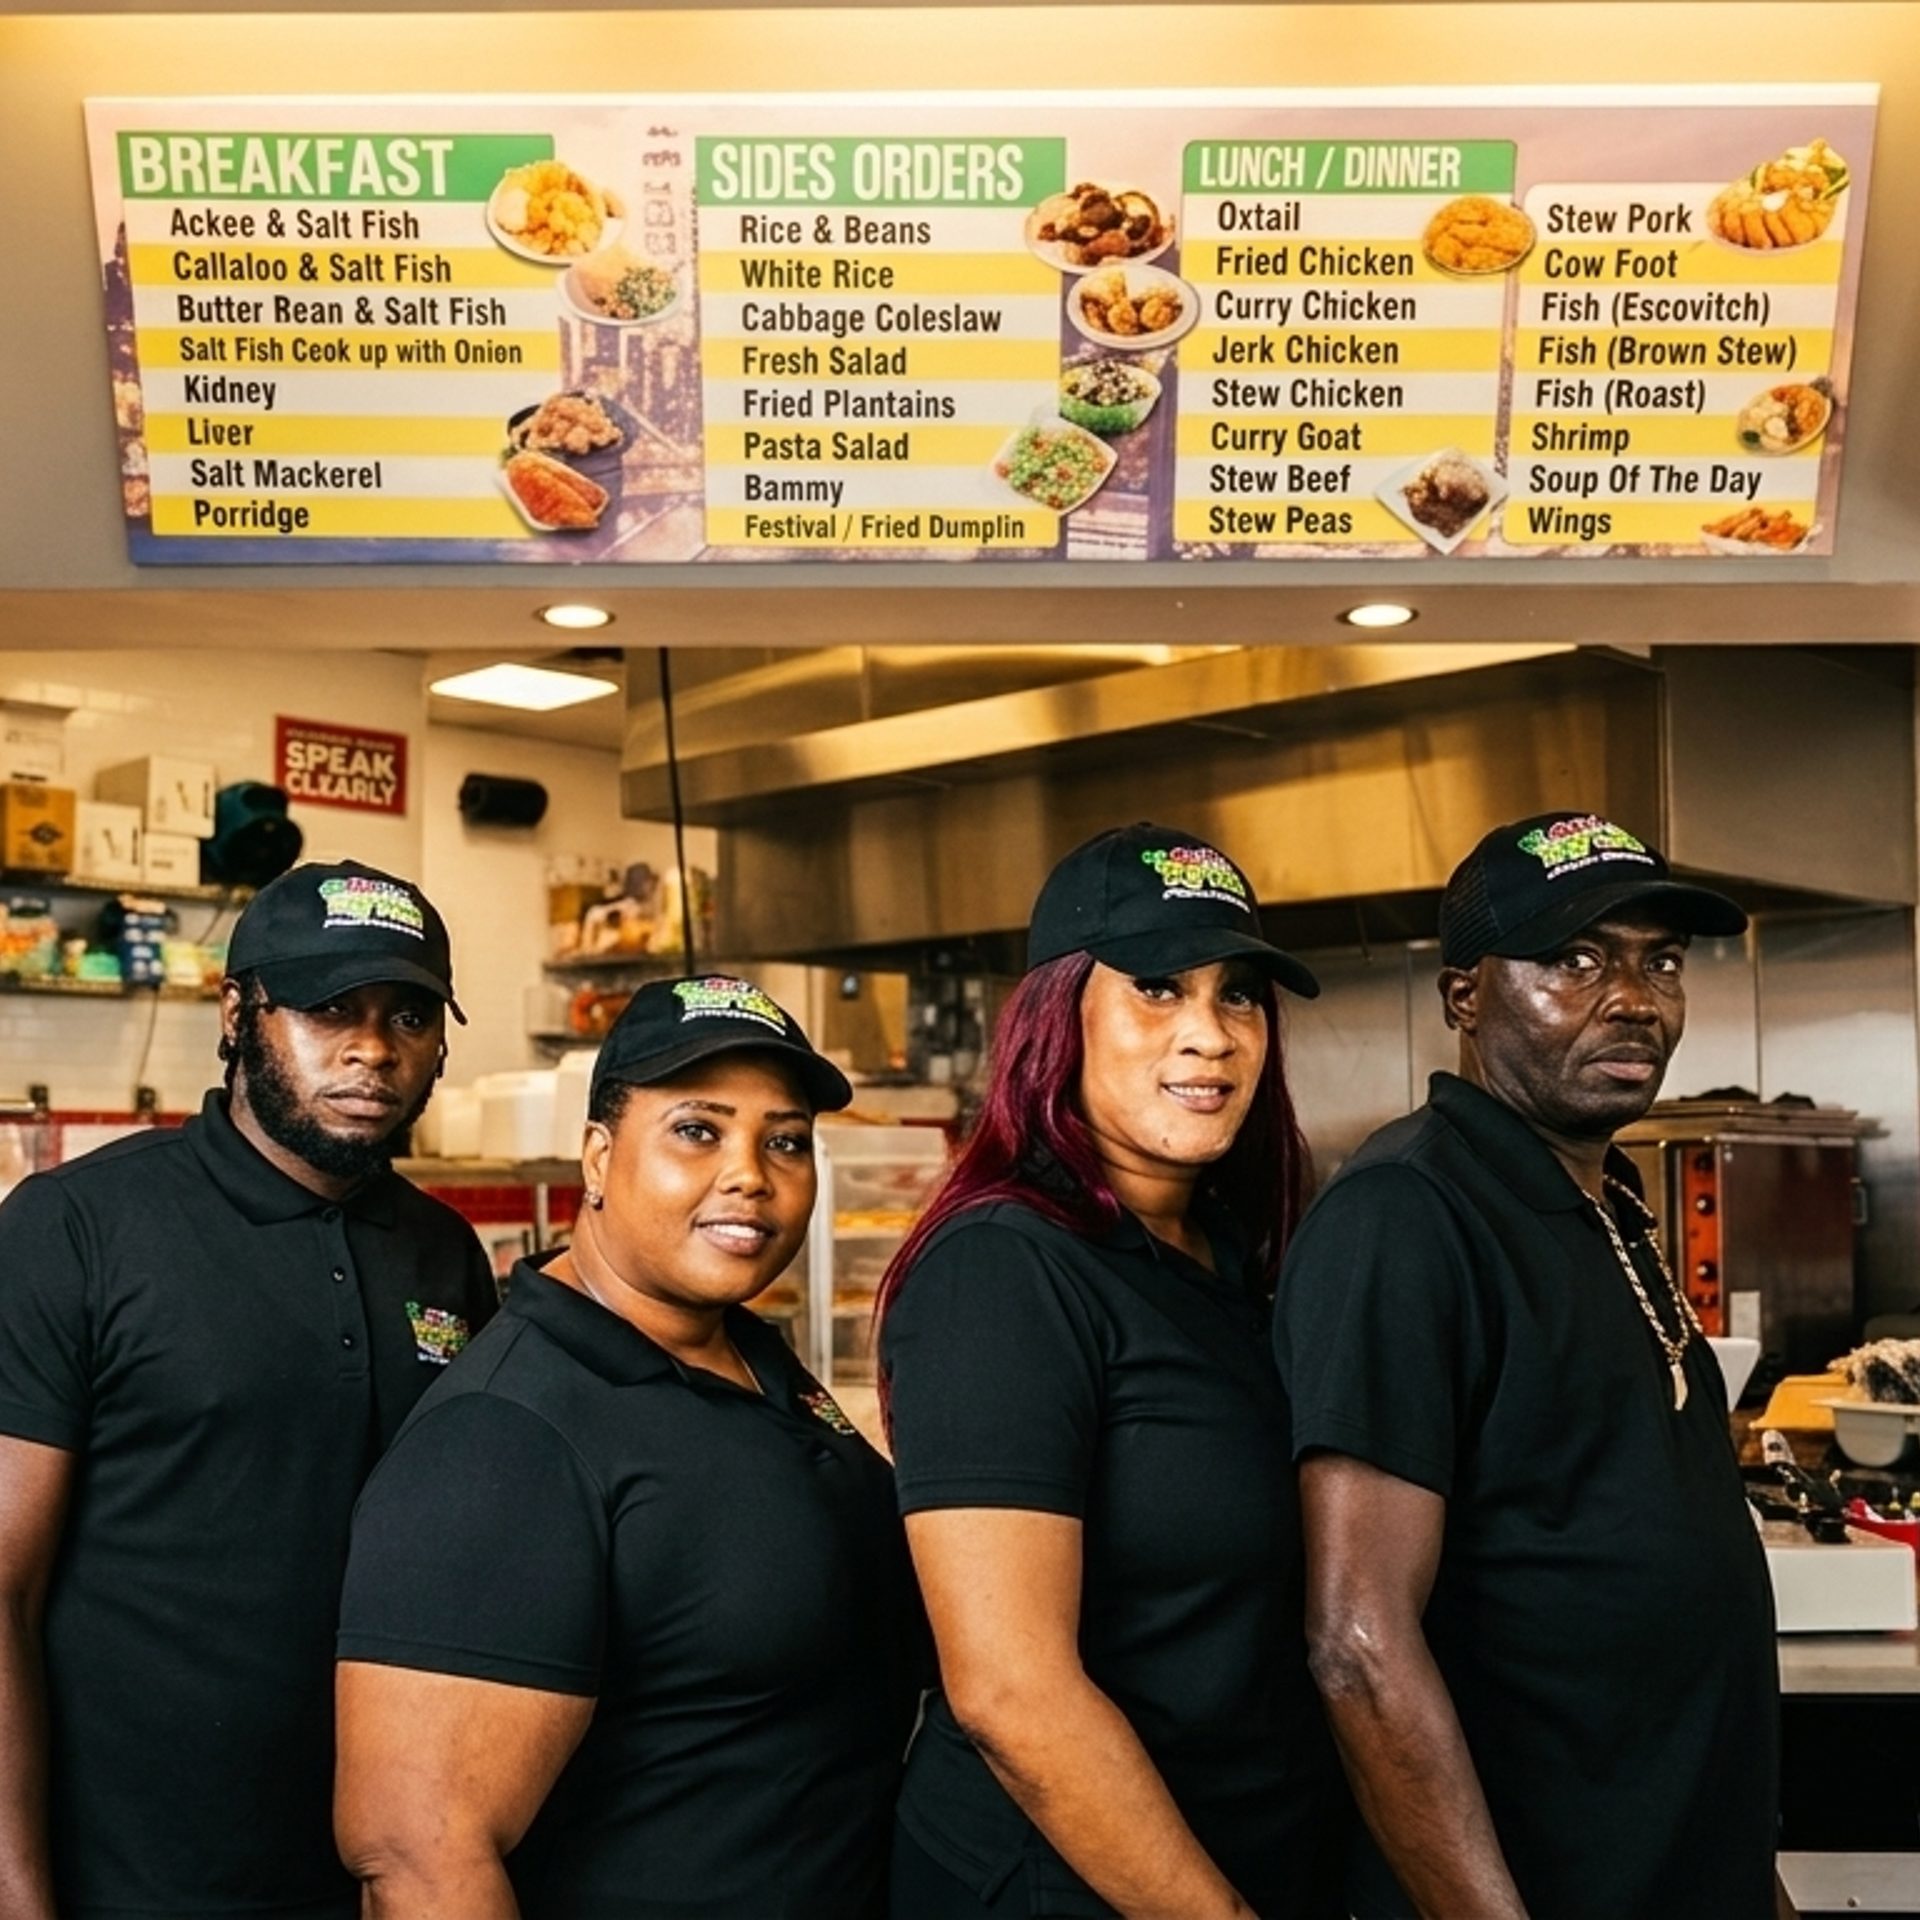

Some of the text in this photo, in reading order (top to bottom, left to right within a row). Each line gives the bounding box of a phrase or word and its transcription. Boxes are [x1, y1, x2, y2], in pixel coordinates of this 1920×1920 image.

[131, 138, 454, 196] BREAKFAST
[712, 143, 835, 200] SIDES
[854, 143, 1022, 200] ORDERS
[1201, 146, 1461, 189] LUNCH / DINNER
[171, 208, 419, 239] Ackee & Salt Fish
[741, 215, 931, 244] Rice & Beans
[1218, 201, 1300, 231] Oxtail
[1547, 203, 1691, 233] Stew Pork
[174, 251, 451, 283] Callaloo & Salt Fish
[740, 259, 893, 288] White Rice
[1217, 246, 1413, 275] Fried Chicken
[1545, 248, 1678, 278] Cow Foot
[177, 294, 263, 323] Butter
[355, 296, 374, 325] &
[385, 297, 439, 325] Salt
[450, 297, 505, 325] Fish
[742, 303, 1001, 339] Cabbage Coleslaw
[1216, 290, 1416, 327] Curry Chicken
[1542, 292, 1770, 327] Fish (Escovitch)
[180, 336, 227, 362] Salt
[235, 337, 283, 362] Fish
[360, 344, 387, 369] up
[396, 339, 445, 363] with
[743, 346, 906, 375] Fresh Salad
[1213, 335, 1398, 364] Jerk Chicken
[1539, 336, 1796, 371] Fish (Brown Stew)
[185, 375, 275, 410] Kidney
[744, 389, 955, 418] Fried Plantains
[1212, 378, 1403, 408] Stew Chicken
[1536, 378, 1705, 414] Fish (Roast)
[187, 418, 253, 446] Liver
[745, 432, 908, 460] Pasta Salad
[1212, 422, 1361, 457] Curry Goat
[1532, 422, 1630, 457] Shrimp
[191, 459, 381, 488] Salt Mackerel
[1210, 464, 1351, 493] Stew Beef
[1530, 465, 1762, 500] Soup Of The Day
[745, 474, 843, 508] Bammy
[194, 499, 309, 535] Porridge
[746, 514, 1024, 545] Festival / Fried Dumplin
[1210, 505, 1352, 534] Stew Peas
[1528, 506, 1611, 541] Wings
[285, 740, 397, 781] SPEAK
